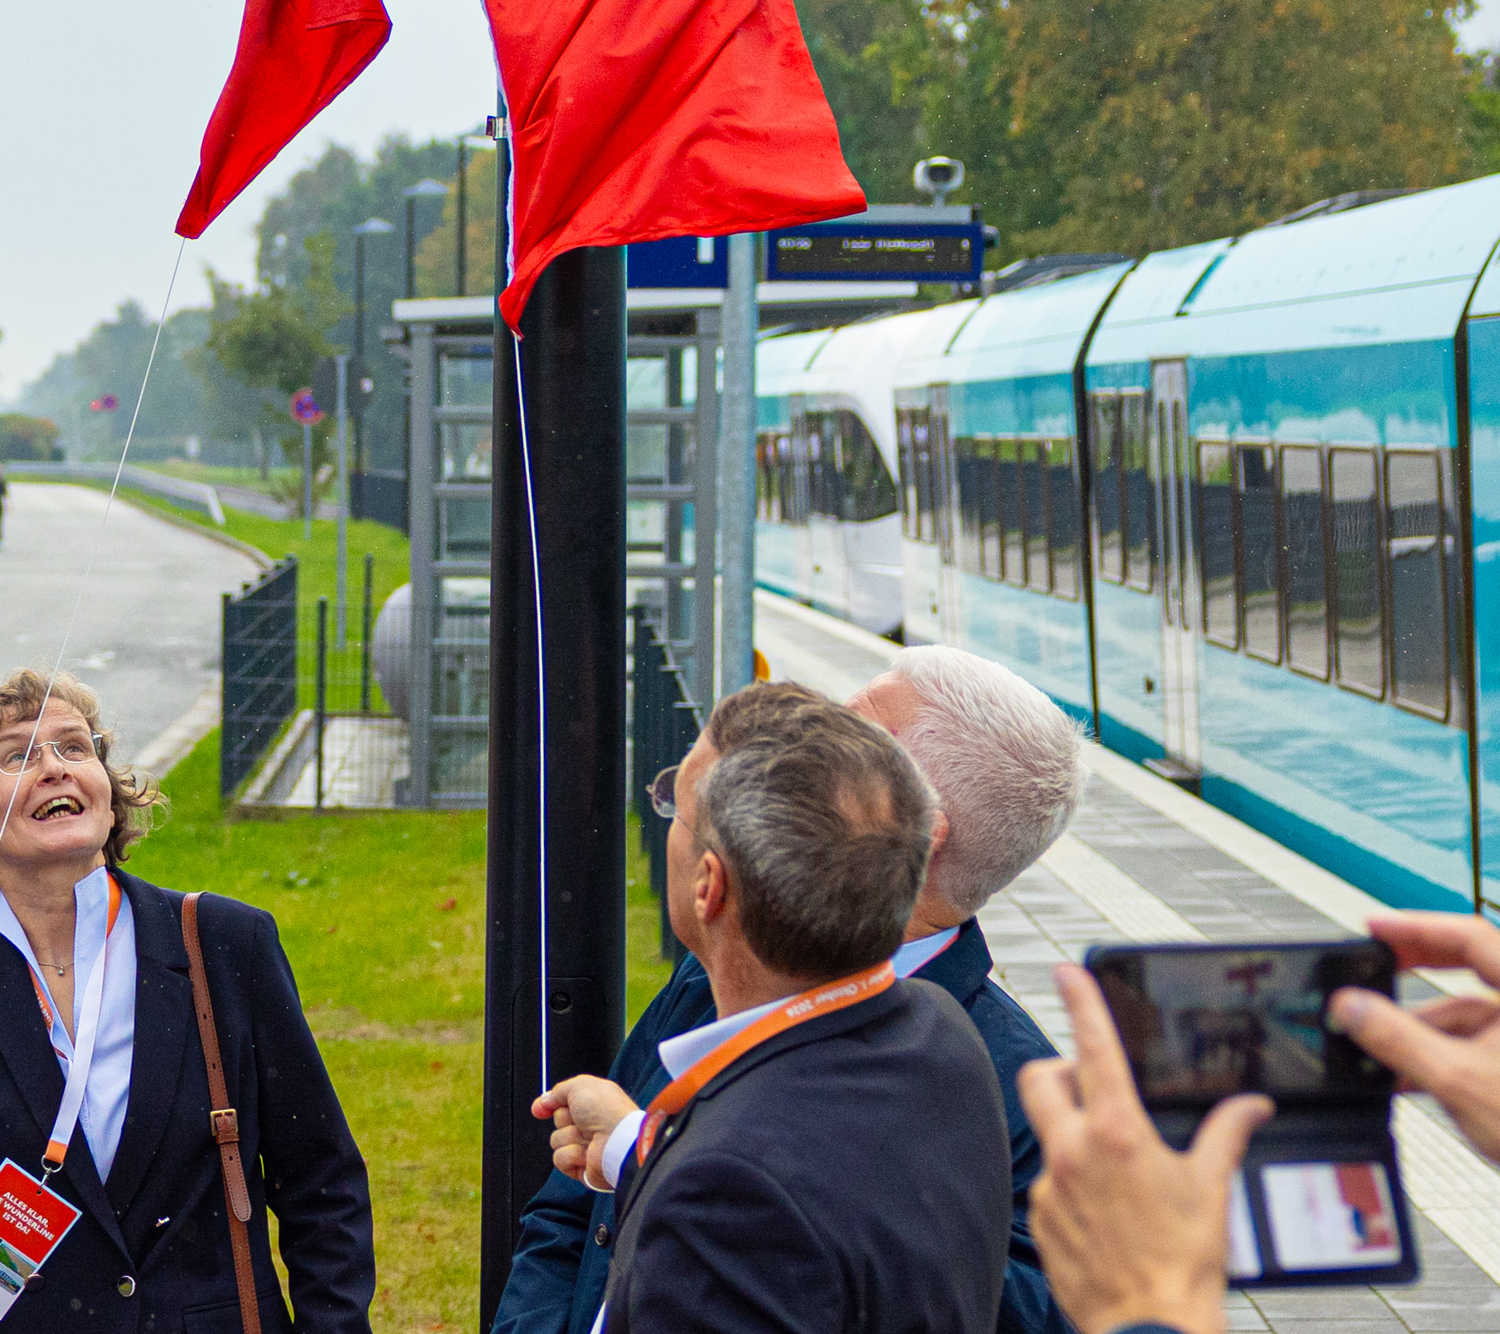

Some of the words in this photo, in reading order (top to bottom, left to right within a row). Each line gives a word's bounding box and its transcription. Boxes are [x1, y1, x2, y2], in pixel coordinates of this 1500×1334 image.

[2, 1211, 17, 1224] IST
[15, 1221, 31, 1235] DA!
[3, 1191, 28, 1211] ALLES
[26, 1207, 49, 1228] KLAR,
[3, 1200, 55, 1241] WUNDERLINE
